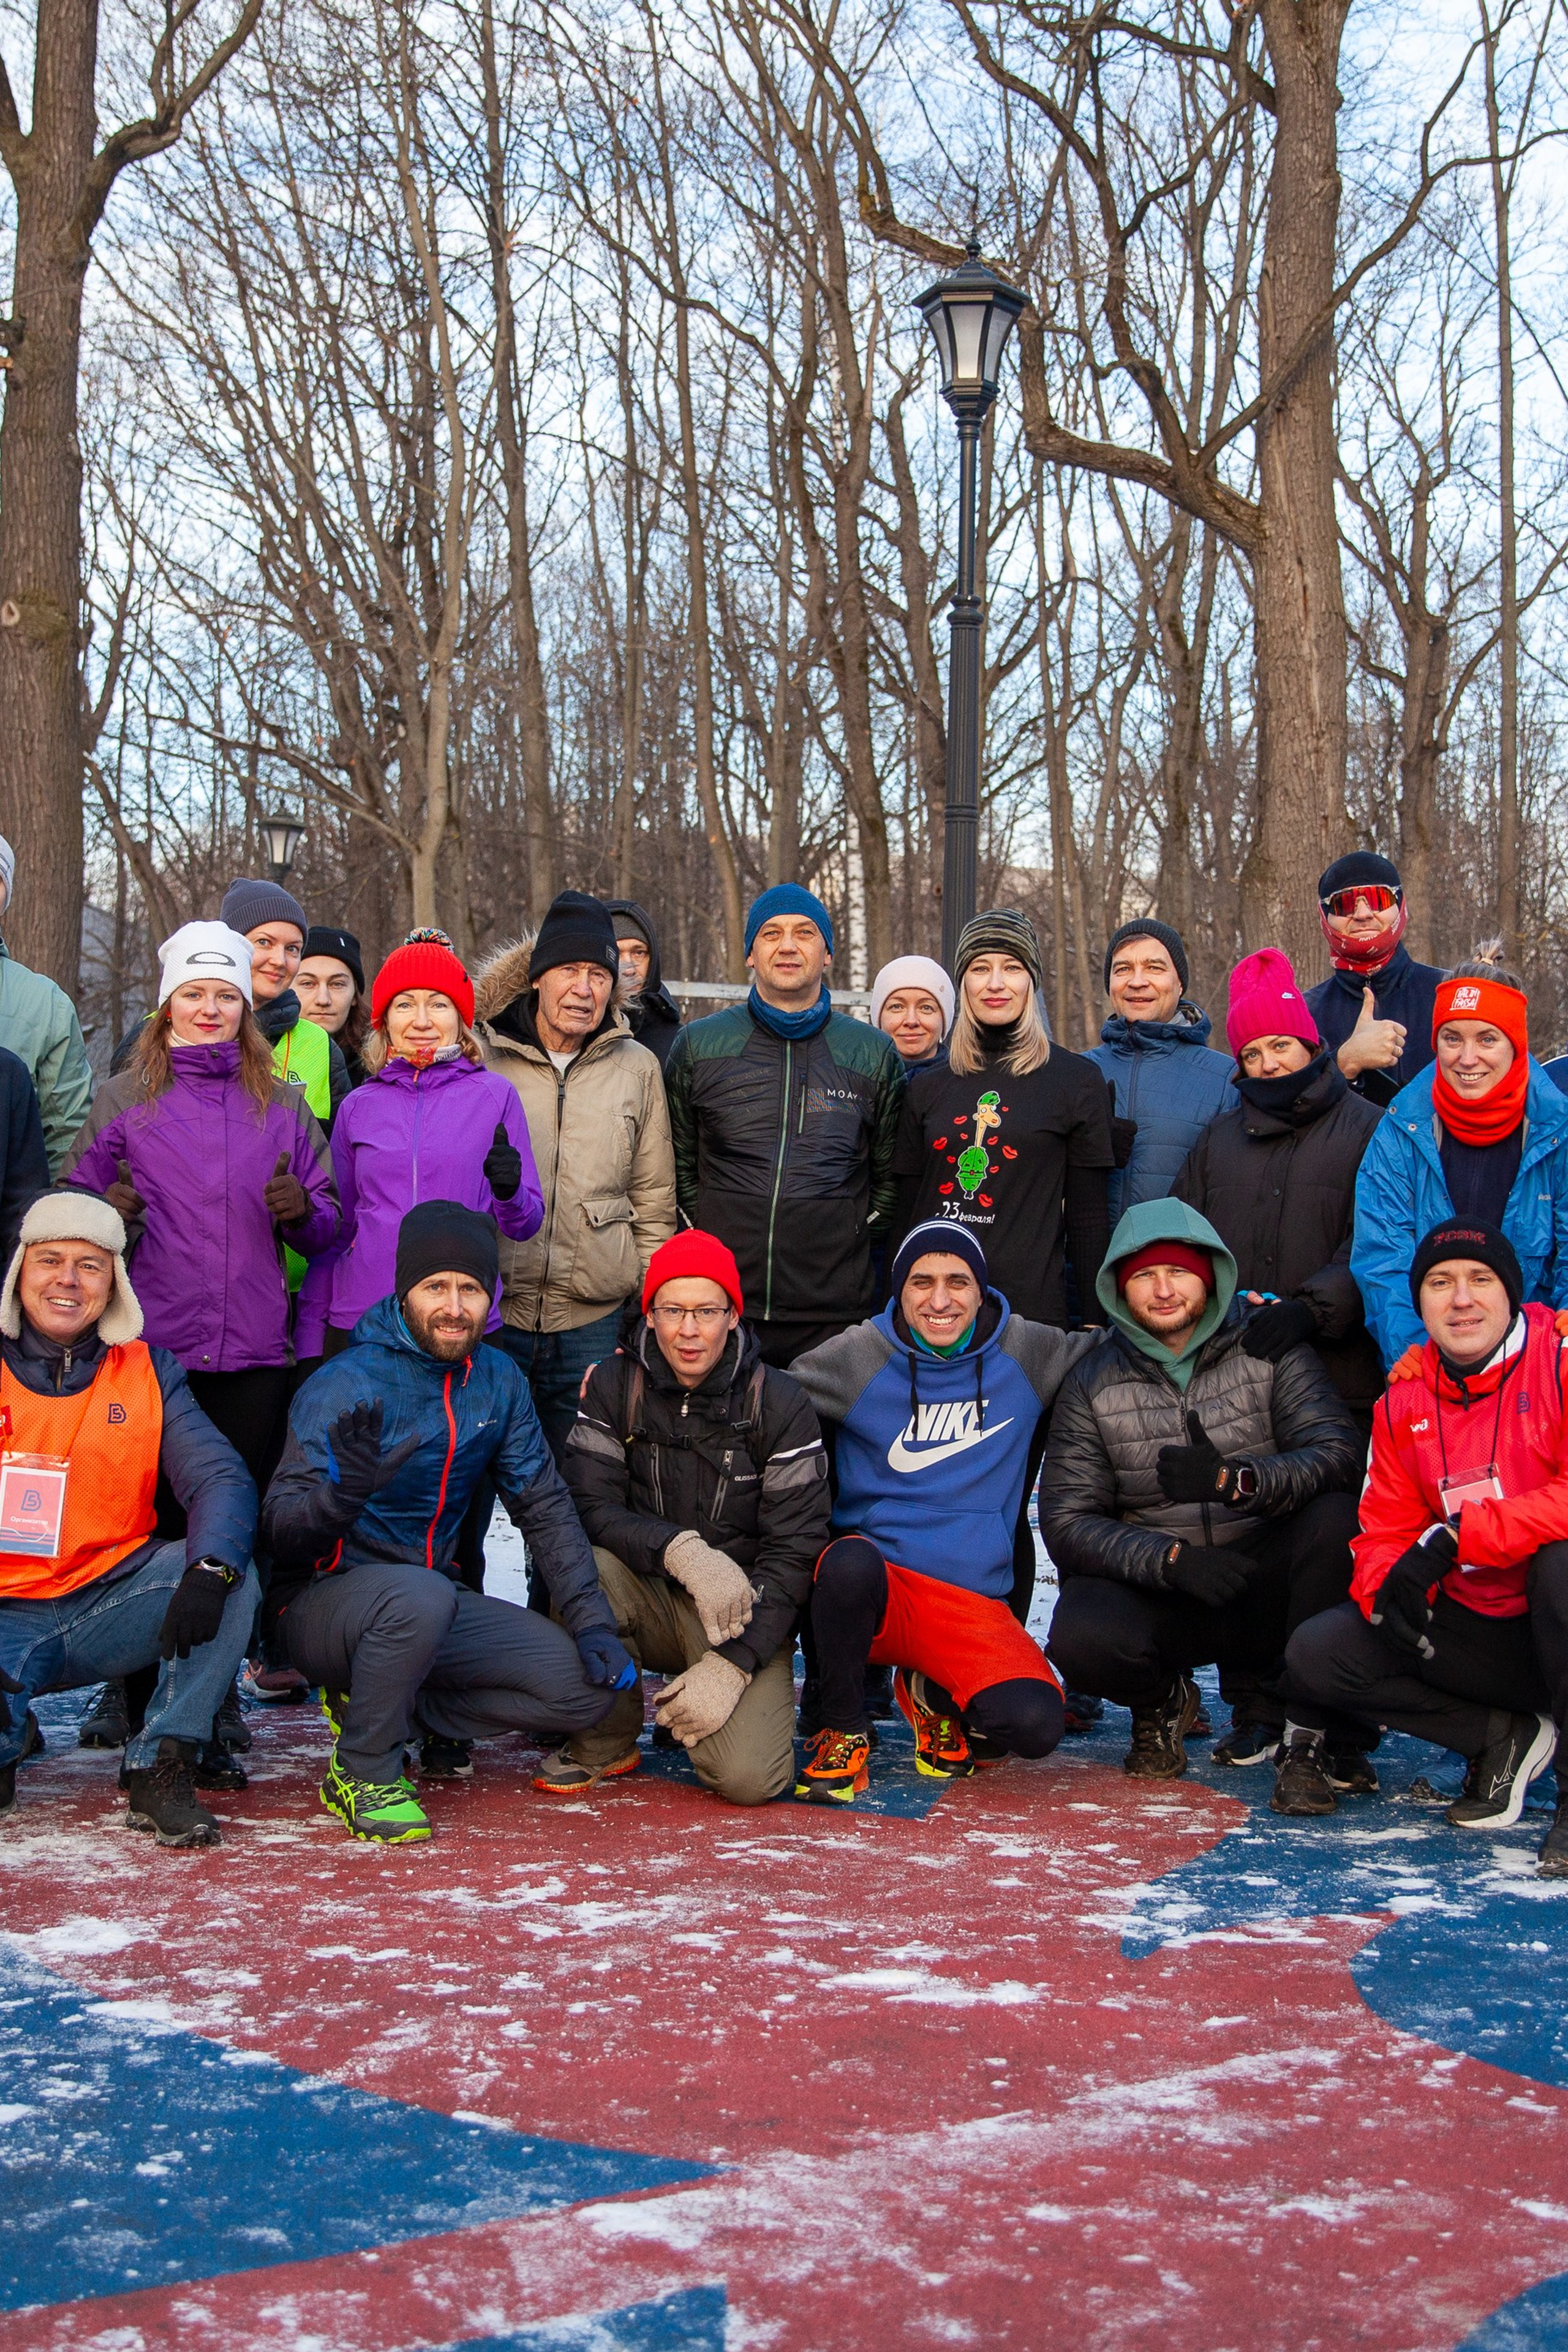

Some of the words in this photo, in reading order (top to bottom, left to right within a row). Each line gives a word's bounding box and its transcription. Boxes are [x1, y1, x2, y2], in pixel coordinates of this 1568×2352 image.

[943, 1201, 960, 1219] 23
[959, 1212, 995, 1223] февраля!
[903, 1399, 989, 1441] NIKE
[10, 1515, 48, 1526] Организатор
